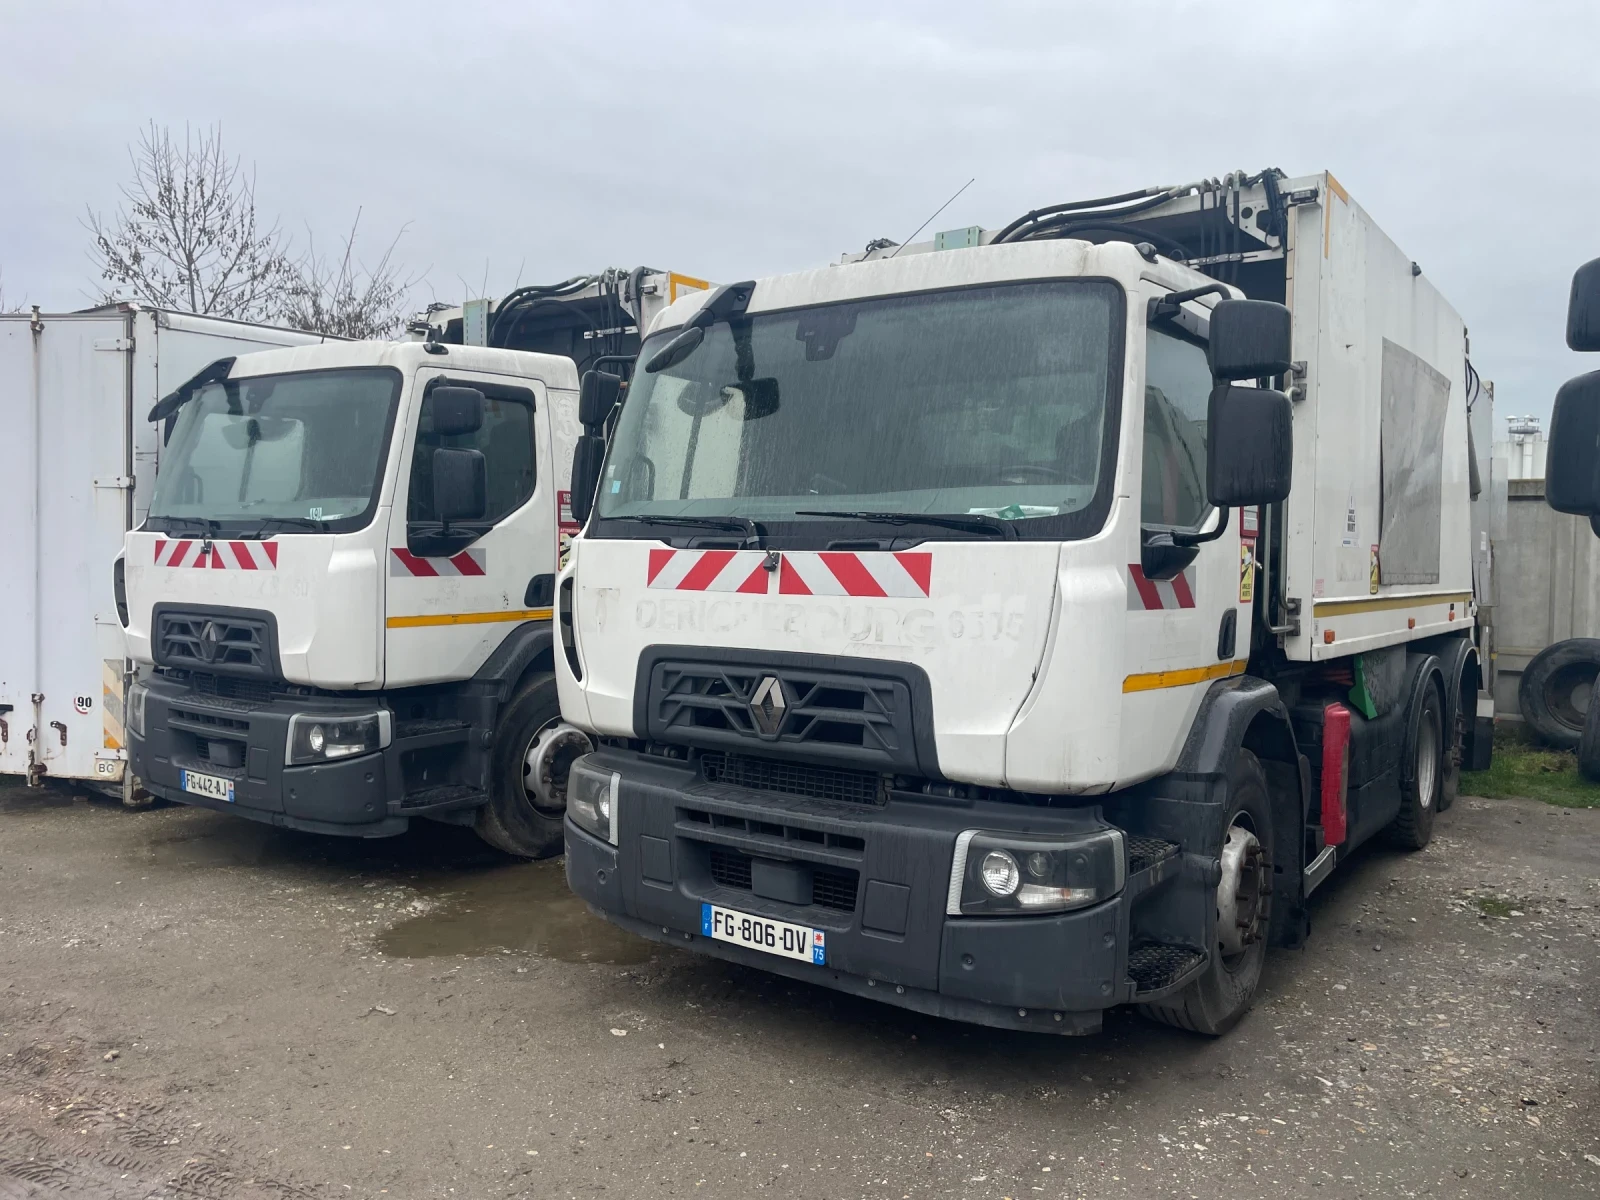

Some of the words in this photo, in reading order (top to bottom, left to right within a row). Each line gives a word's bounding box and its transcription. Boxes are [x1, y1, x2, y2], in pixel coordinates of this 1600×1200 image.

[77, 696, 92, 708] 90
[98, 763, 115, 773] BG
[186, 773, 227, 797] FG-442-AJ
[714, 911, 806, 954] FG-806-DV
[814, 948, 824, 960] 75
